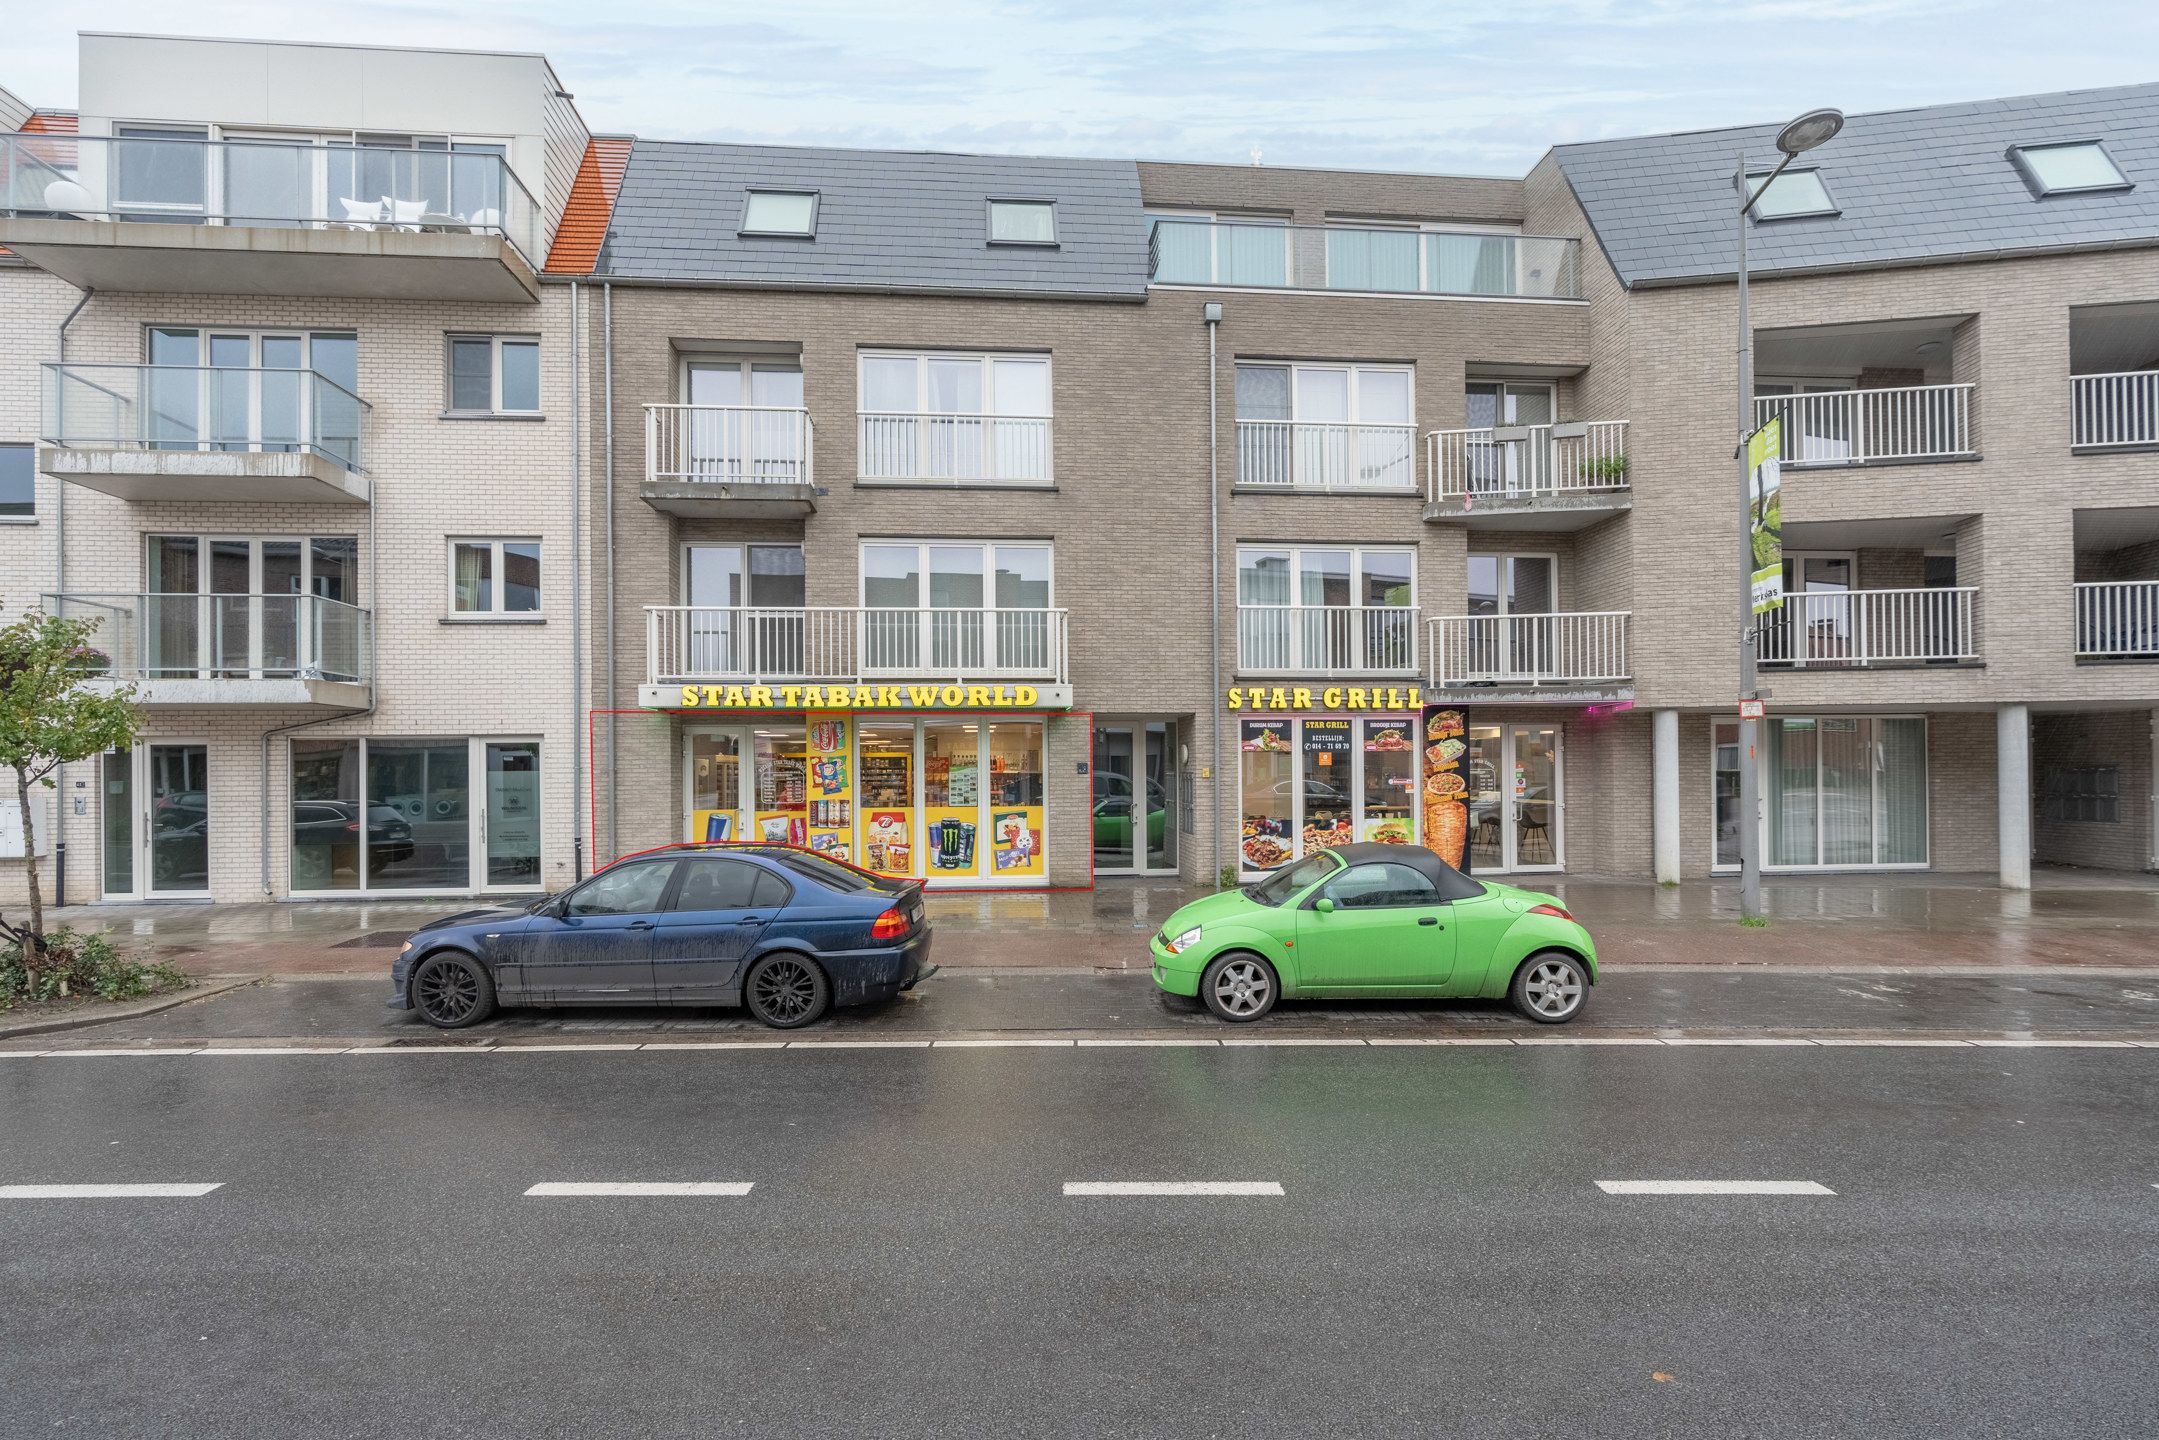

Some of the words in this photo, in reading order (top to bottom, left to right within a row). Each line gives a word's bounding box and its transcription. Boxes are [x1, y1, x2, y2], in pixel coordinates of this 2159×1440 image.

[681, 686, 774, 707] STAR
[780, 686, 902, 707] TABAK
[907, 686, 1038, 706] WORLD
[1228, 688, 1312, 709] STAR
[1323, 688, 1424, 709] GRILL
[1305, 721, 1325, 729] STAR
[1326, 721, 1349, 729] GRILL
